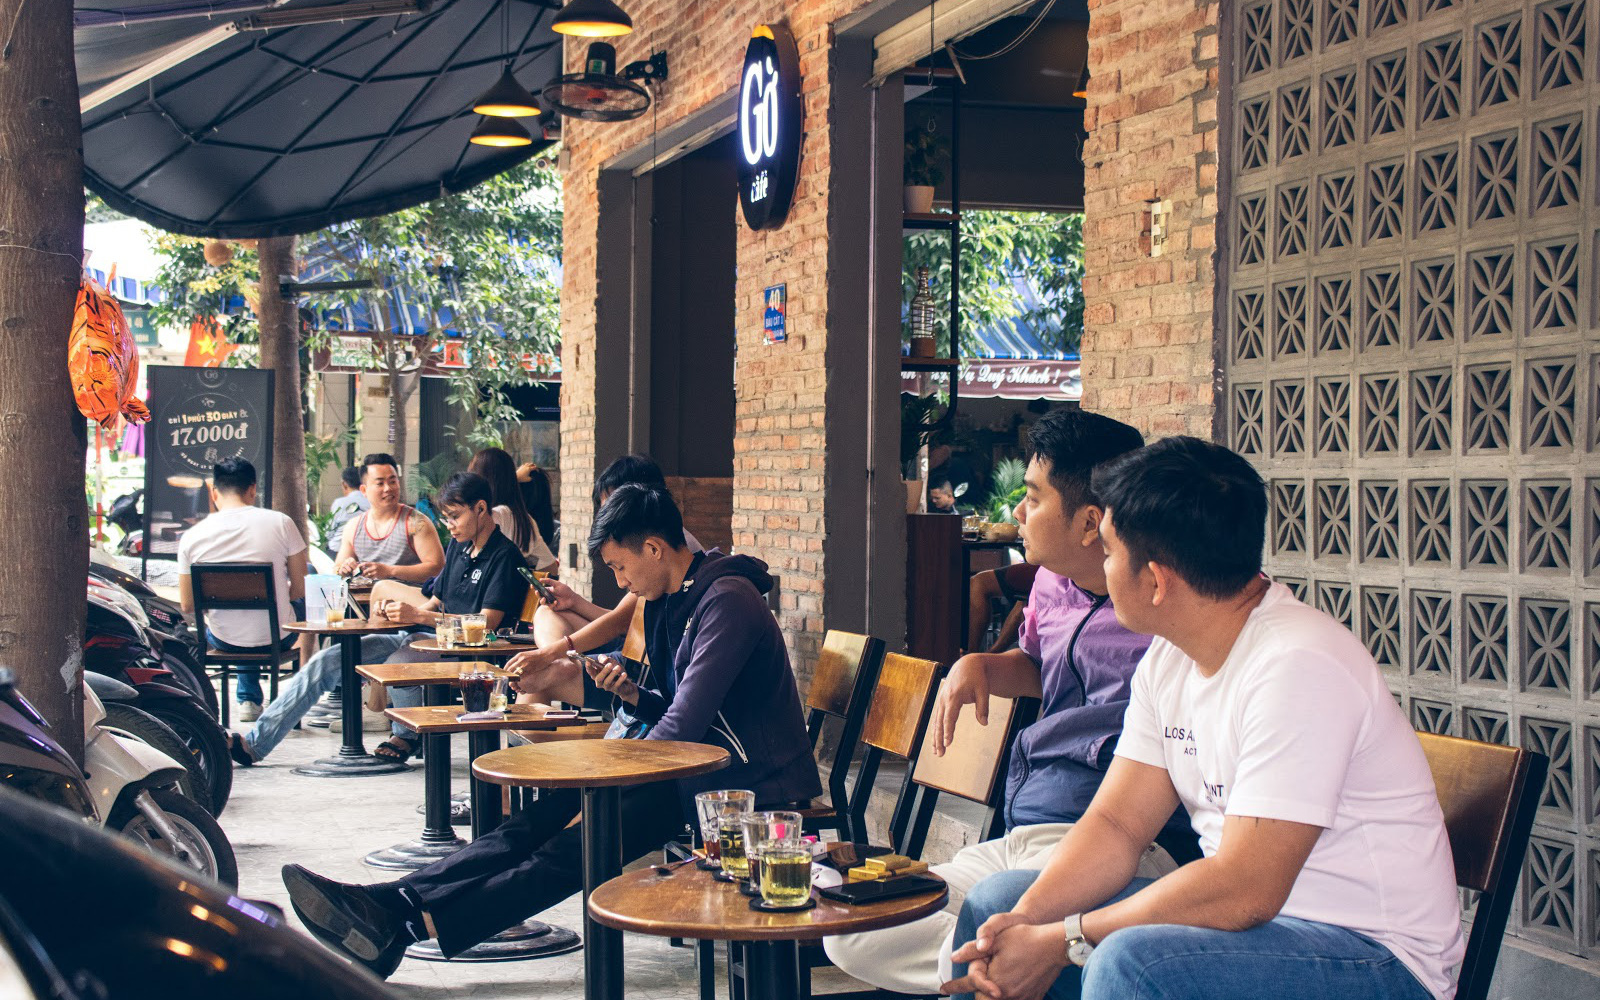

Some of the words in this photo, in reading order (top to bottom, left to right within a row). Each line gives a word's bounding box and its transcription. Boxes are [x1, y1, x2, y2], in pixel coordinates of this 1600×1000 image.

[769, 289, 780, 311] 40
[977, 364, 1005, 389] Quý
[1006, 366, 1050, 384] Khách
[1052, 369, 1061, 384] !
[181, 413, 188, 425] 1
[240, 409, 248, 418] &
[1165, 727, 1185, 740] LOS
